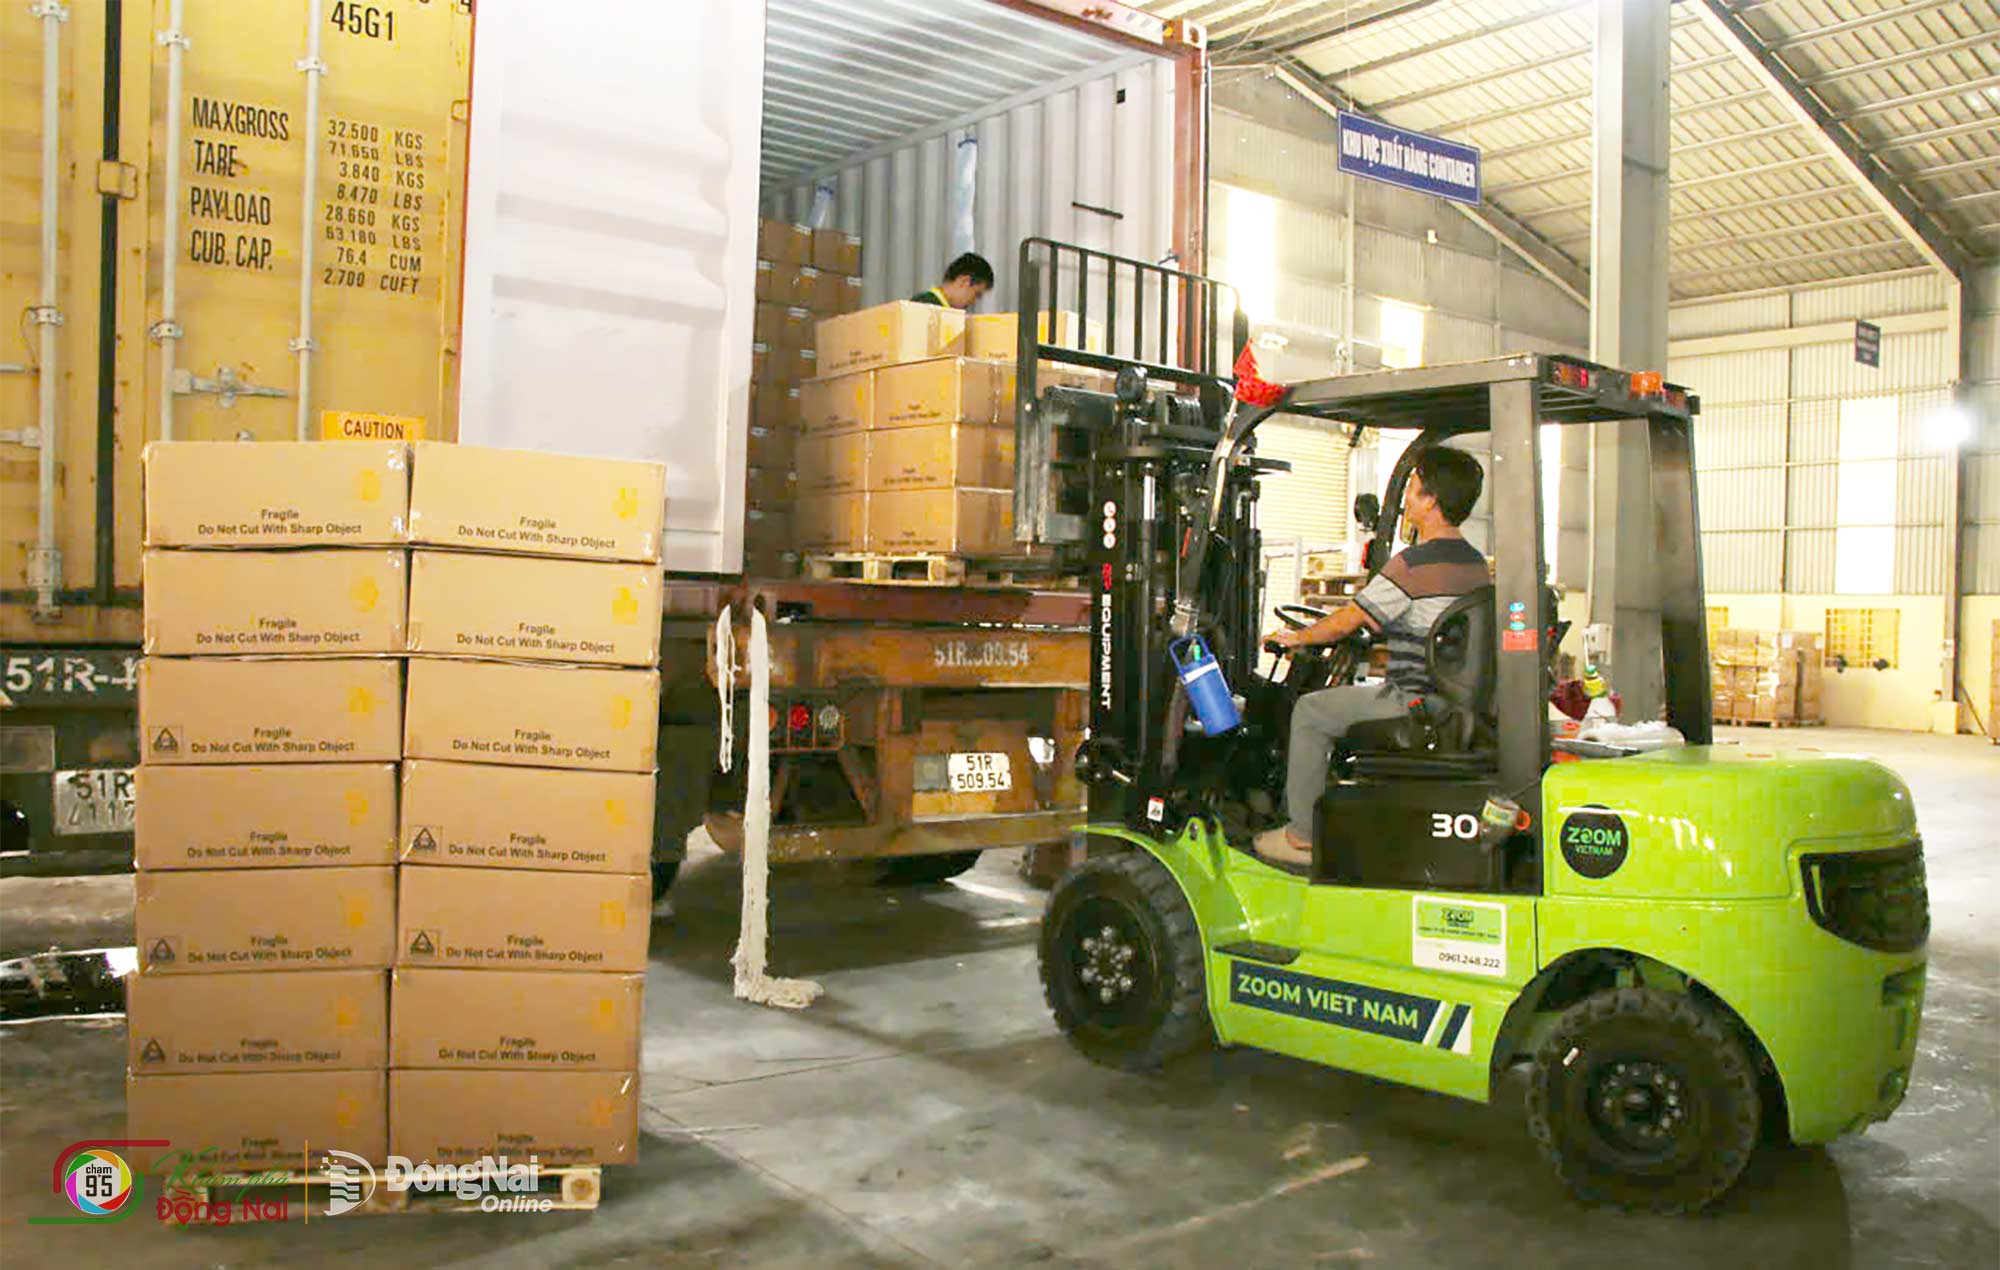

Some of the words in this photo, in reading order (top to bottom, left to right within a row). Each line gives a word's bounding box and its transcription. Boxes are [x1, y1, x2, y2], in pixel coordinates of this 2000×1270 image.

[331, 1, 393, 41] 45G1
[193, 97, 289, 141] MAXGROSS
[395, 131, 423, 150] KGS
[194, 140, 238, 177] TARE
[395, 152, 423, 169] LBS
[1343, 128, 1362, 158] KHU
[1429, 153, 1475, 187] CONTAINER
[396, 170, 424, 189] KGS
[191, 186, 270, 225] PAYLOAD
[394, 192, 422, 211] LBS
[392, 214, 420, 232] KGS
[191, 230, 230, 266] CUB.
[236, 235, 272, 270] CAP.
[392, 235, 421, 250] LBS
[337, 247, 366, 266] 76.4
[390, 254, 421, 272] CUM
[380, 275, 419, 294] CUFT
[344, 419, 404, 439] CAUTION
[261, 510, 299, 522] Fragile
[520, 516, 556, 530] Fragile
[199, 525, 213, 534] Do
[217, 524, 237, 534] Not
[240, 524, 259, 534] Cut
[262, 523, 287, 533] With
[290, 524, 323, 535] Sharp
[326, 523, 362, 535] Object
[458, 526, 473, 536] Do
[476, 527, 495, 538] Not
[498, 529, 517, 539] Cut
[520, 530, 543, 542] With
[547, 531, 578, 547] Sharp
[581, 536, 615, 550] Object
[259, 618, 296, 630] Fragile
[519, 623, 555, 636] Fragile
[196, 633, 212, 644] Do
[215, 633, 235, 643] Not
[237, 633, 257, 643] Cut
[259, 633, 285, 642] With
[288, 632, 320, 644] Sharp
[324, 632, 360, 644] Object
[457, 633, 472, 644] Do
[476, 635, 494, 645] Not
[497, 636, 515, 646] Cut
[518, 638, 542, 648] With
[546, 639, 577, 651] Sharp
[580, 641, 614, 653] Object
[1101, 594, 1112, 710] EQUIPMENT
[254, 728, 291, 740] Fragile
[515, 729, 551, 742] Fragile
[192, 743, 206, 753] Do
[210, 743, 229, 752] Not
[233, 742, 252, 752] Cut
[254, 742, 279, 751] With
[283, 742, 315, 753] Sharp
[319, 741, 354, 754] Object
[453, 740, 467, 750] Do
[471, 741, 490, 751] Not
[493, 742, 511, 752] Cut
[513, 744, 538, 754] With
[541, 745, 573, 759] Sharp
[576, 747, 610, 760] Object
[966, 755, 992, 770] 51R
[76, 773, 131, 800] 51R
[958, 773, 1004, 789] 509.54
[1432, 814, 1478, 838] 30
[250, 832, 288, 843] Fragile
[510, 833, 546, 846] Fragile
[1567, 827, 1621, 846] ZOOM
[449, 844, 463, 854] Do
[467, 845, 485, 855] Not
[489, 846, 507, 857] Cut
[510, 848, 534, 858] With
[537, 849, 568, 861] Sharp
[572, 850, 606, 862] Object
[251, 935, 288, 948] Fragile
[507, 935, 543, 947] Fragile
[446, 948, 461, 958] Do
[464, 948, 483, 959] Not
[486, 949, 505, 959] Cut
[507, 950, 531, 960] With
[534, 951, 566, 962] Sharp
[569, 951, 603, 963] Object
[1439, 951, 1500, 968] 0961.248.222
[1238, 974, 1300, 1004] ZOOM
[1307, 987, 1357, 1016] VIET
[1363, 1000, 1418, 1030] NAM
